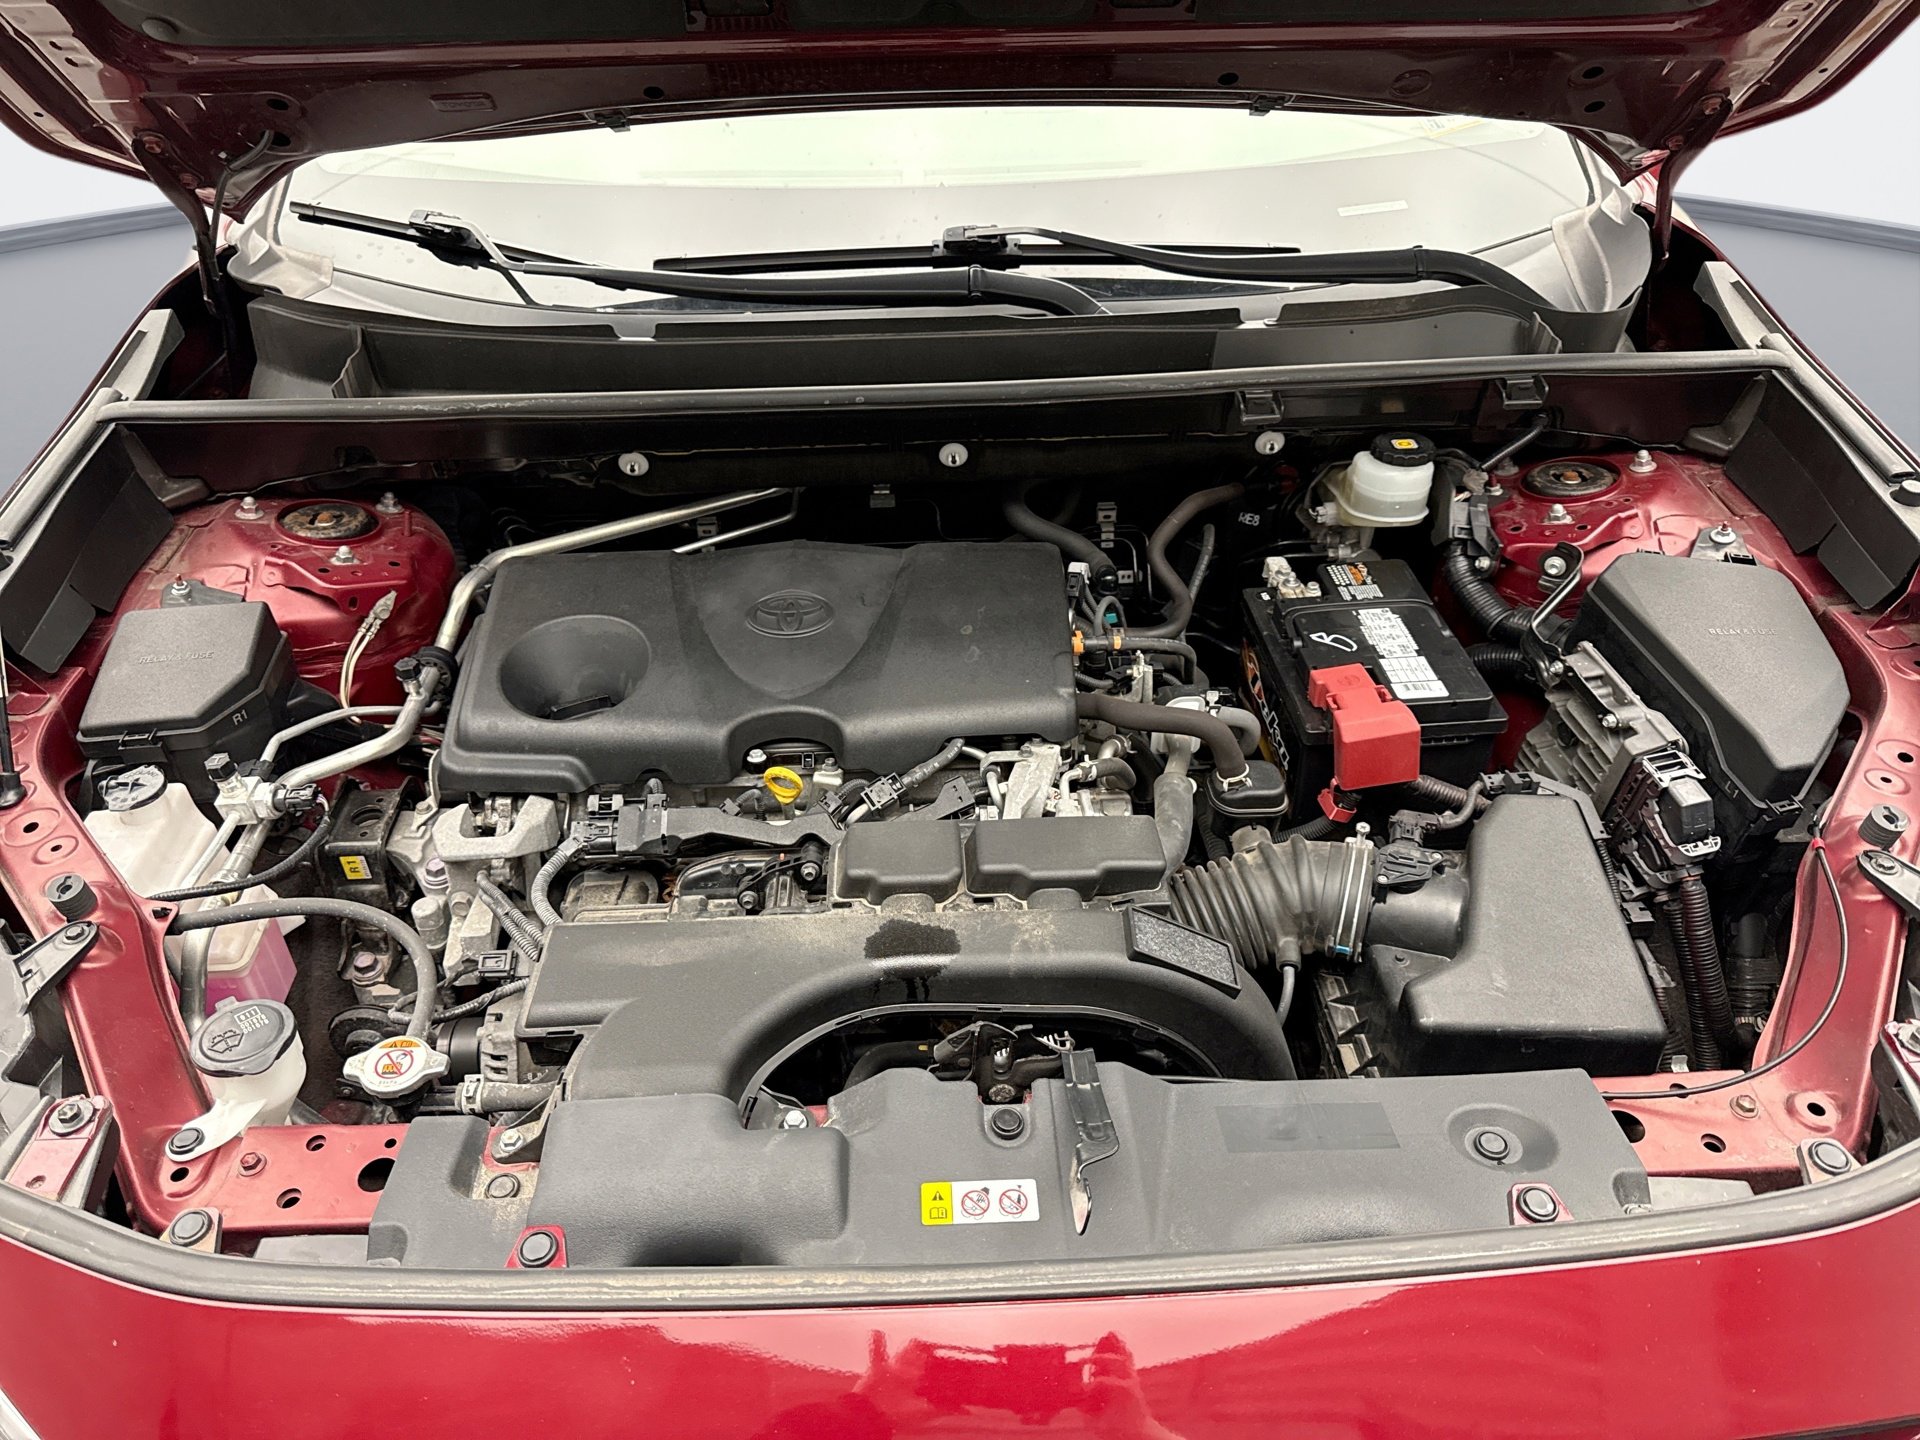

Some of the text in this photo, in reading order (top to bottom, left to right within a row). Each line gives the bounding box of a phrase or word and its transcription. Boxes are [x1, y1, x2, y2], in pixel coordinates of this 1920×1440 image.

[1706, 627, 1742, 637] RELAY
[138, 655, 177, 664] RELAY
[184, 651, 215, 660] FUSE
[232, 709, 248, 726] R1
[1725, 780, 1739, 799] L1
[346, 860, 361, 874] R1
